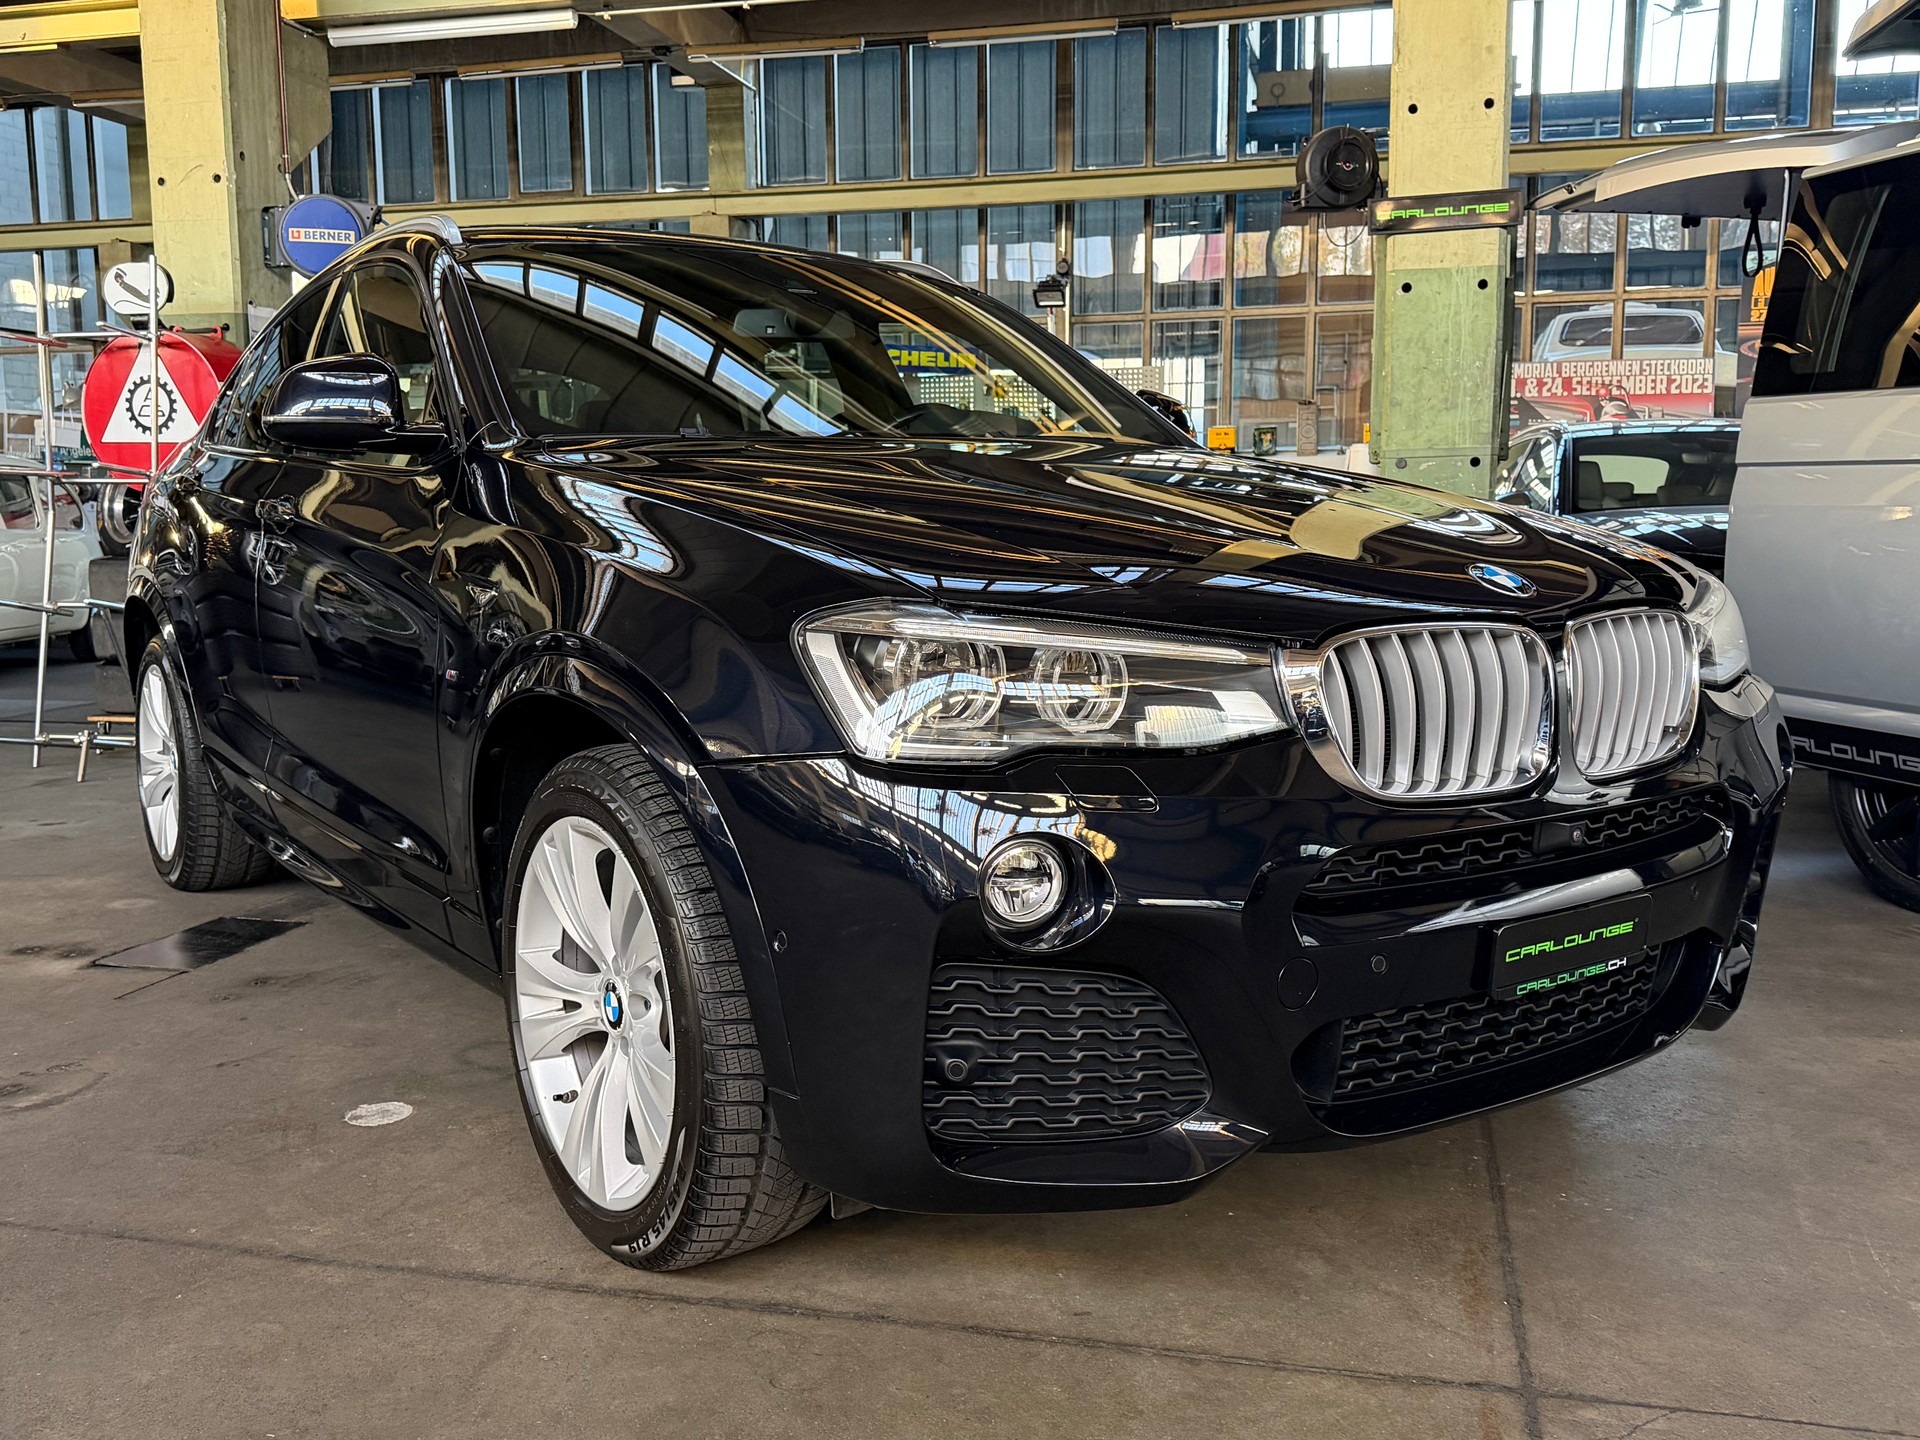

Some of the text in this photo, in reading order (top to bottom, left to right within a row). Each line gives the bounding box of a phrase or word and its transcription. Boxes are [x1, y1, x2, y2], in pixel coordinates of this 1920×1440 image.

[304, 230, 352, 242] BERNER
[887, 348, 976, 368] CHELIN
[1511, 358, 1714, 379] MORIAL BERGRENNEN STECKBORN
[1525, 378, 1539, 397] &
[1542, 378, 1569, 397] 24.
[1572, 374, 1668, 396] SEPTEMBER
[1671, 374, 1714, 394] 2023
[1791, 735, 1920, 773] RLOUNG
[1505, 921, 1634, 963] CARLOUNGE
[1516, 957, 1628, 996] CARLOUNGE.CH
